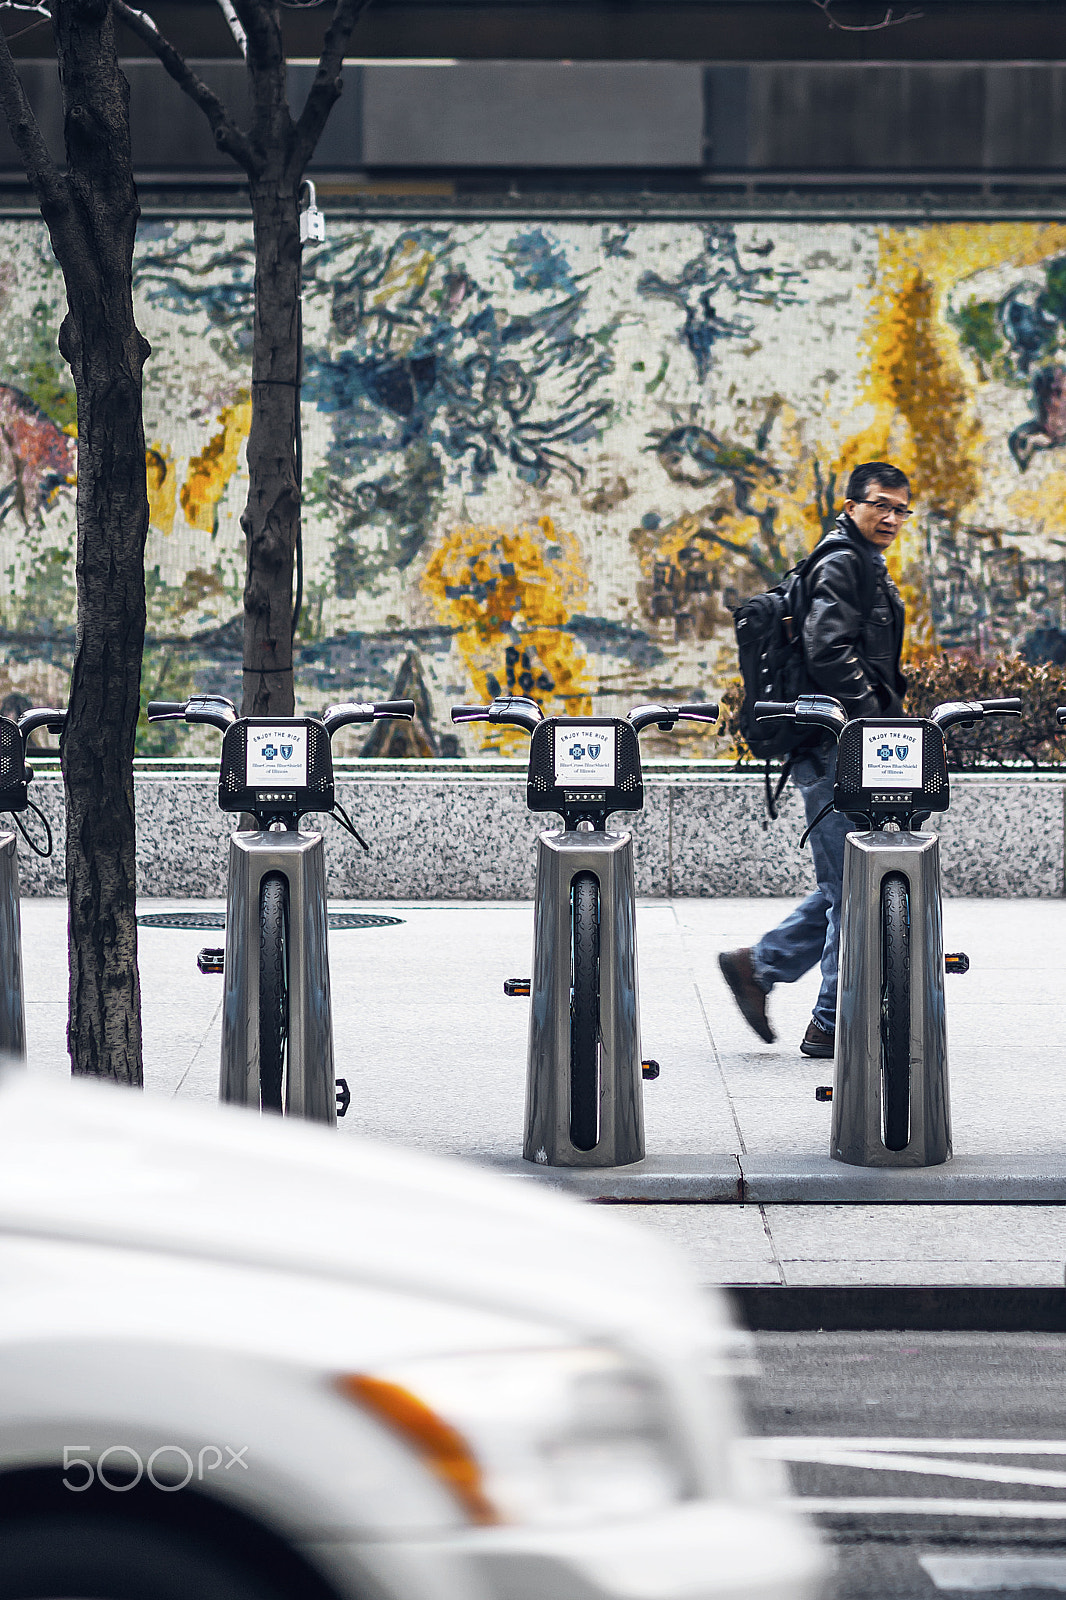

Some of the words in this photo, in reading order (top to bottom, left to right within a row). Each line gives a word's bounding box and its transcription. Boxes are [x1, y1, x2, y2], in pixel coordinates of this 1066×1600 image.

[253, 732, 271, 742] ENJOY
[288, 734, 301, 742] RIDE
[561, 732, 579, 742] ENJOY
[595, 733, 608, 742] RIDE
[869, 733, 887, 743] ENJOY
[903, 734, 917, 743] RIDE
